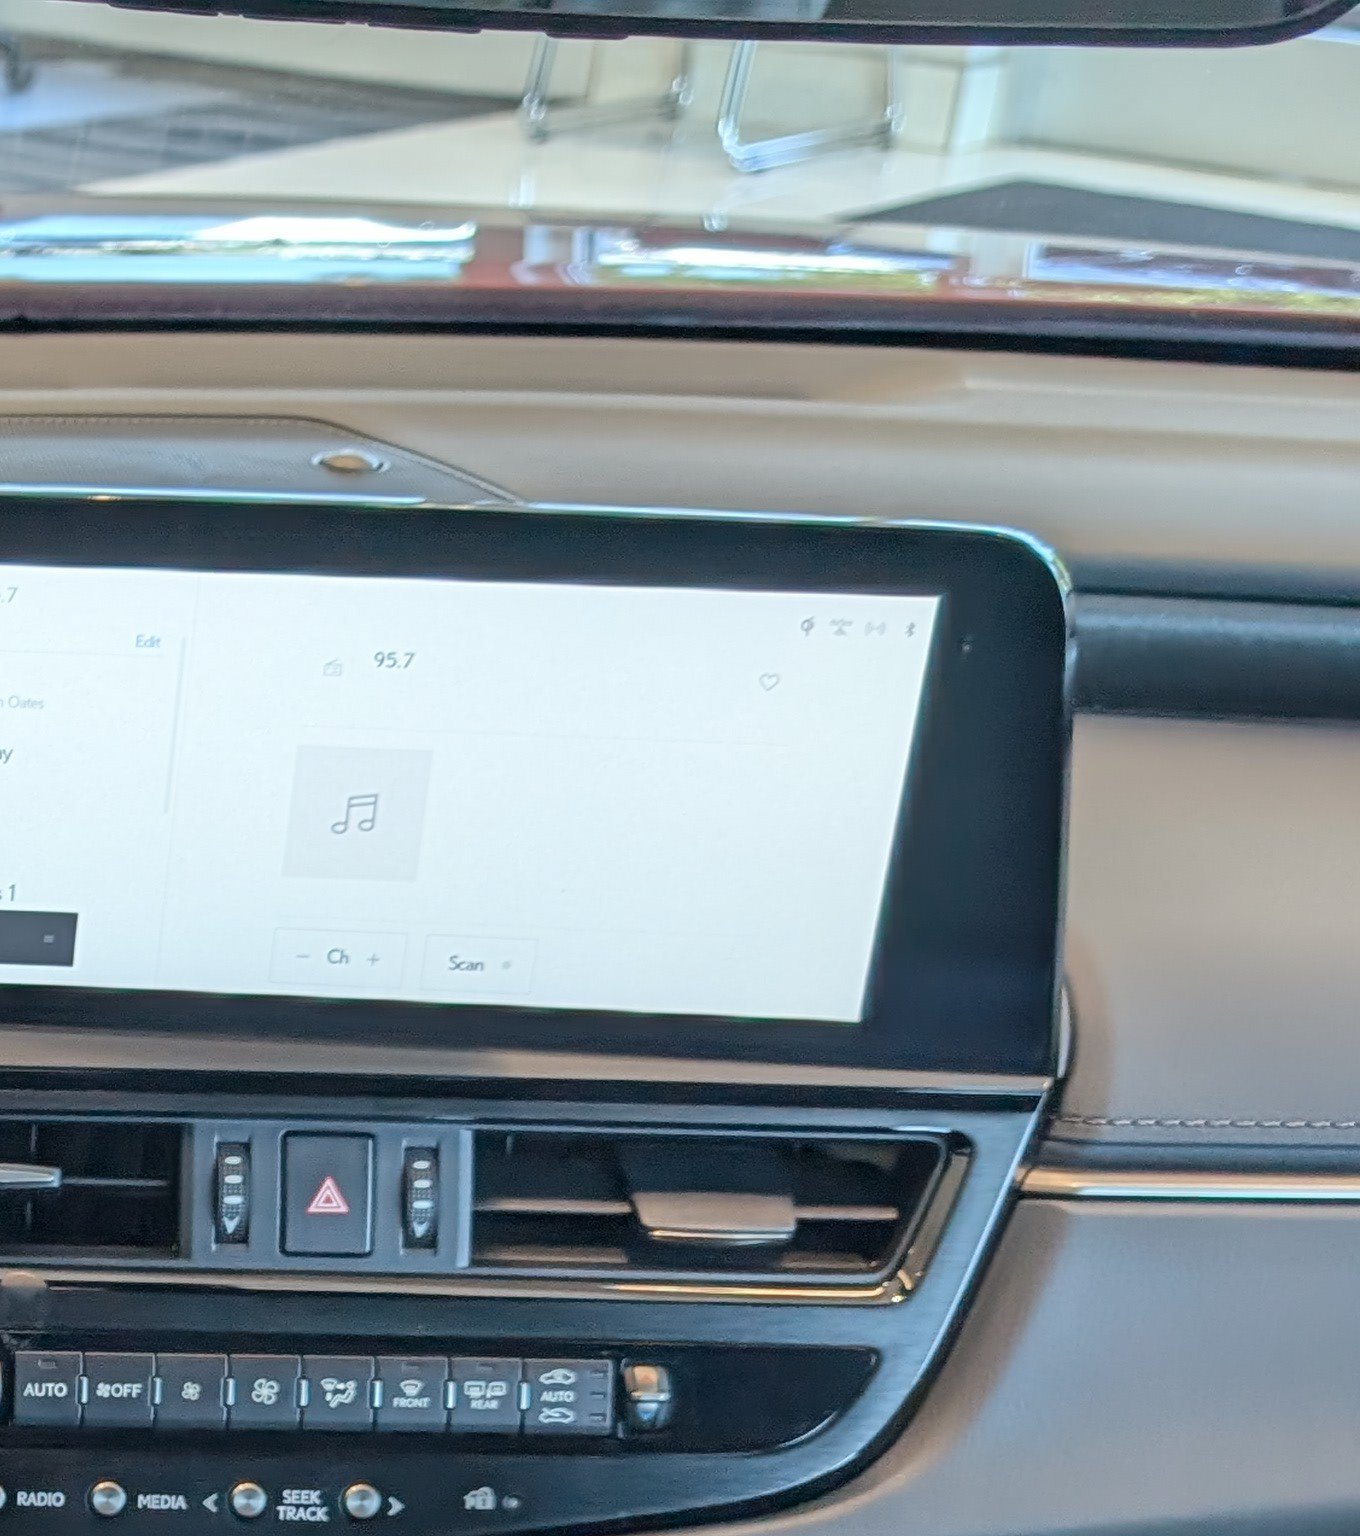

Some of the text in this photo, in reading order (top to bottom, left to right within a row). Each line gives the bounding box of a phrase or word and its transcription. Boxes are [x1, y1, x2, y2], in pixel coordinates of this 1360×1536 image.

[135, 634, 162, 649] Edit
[373, 651, 416, 669] 95.7
[7, 694, 45, 710] Oates
[8, 884, 16, 902] 1
[326, 948, 350, 966] Ch
[447, 955, 485, 973] Scan
[22, 1381, 69, 1398] AUTO
[110, 1382, 144, 1398] OFF
[540, 1390, 576, 1403] AUTO
[392, 1397, 431, 1409] FRONT
[16, 1490, 66, 1508] RADIO
[137, 1493, 187, 1510] MEDIA
[281, 1489, 321, 1505] SEEK
[276, 1505, 329, 1522] TRACK
